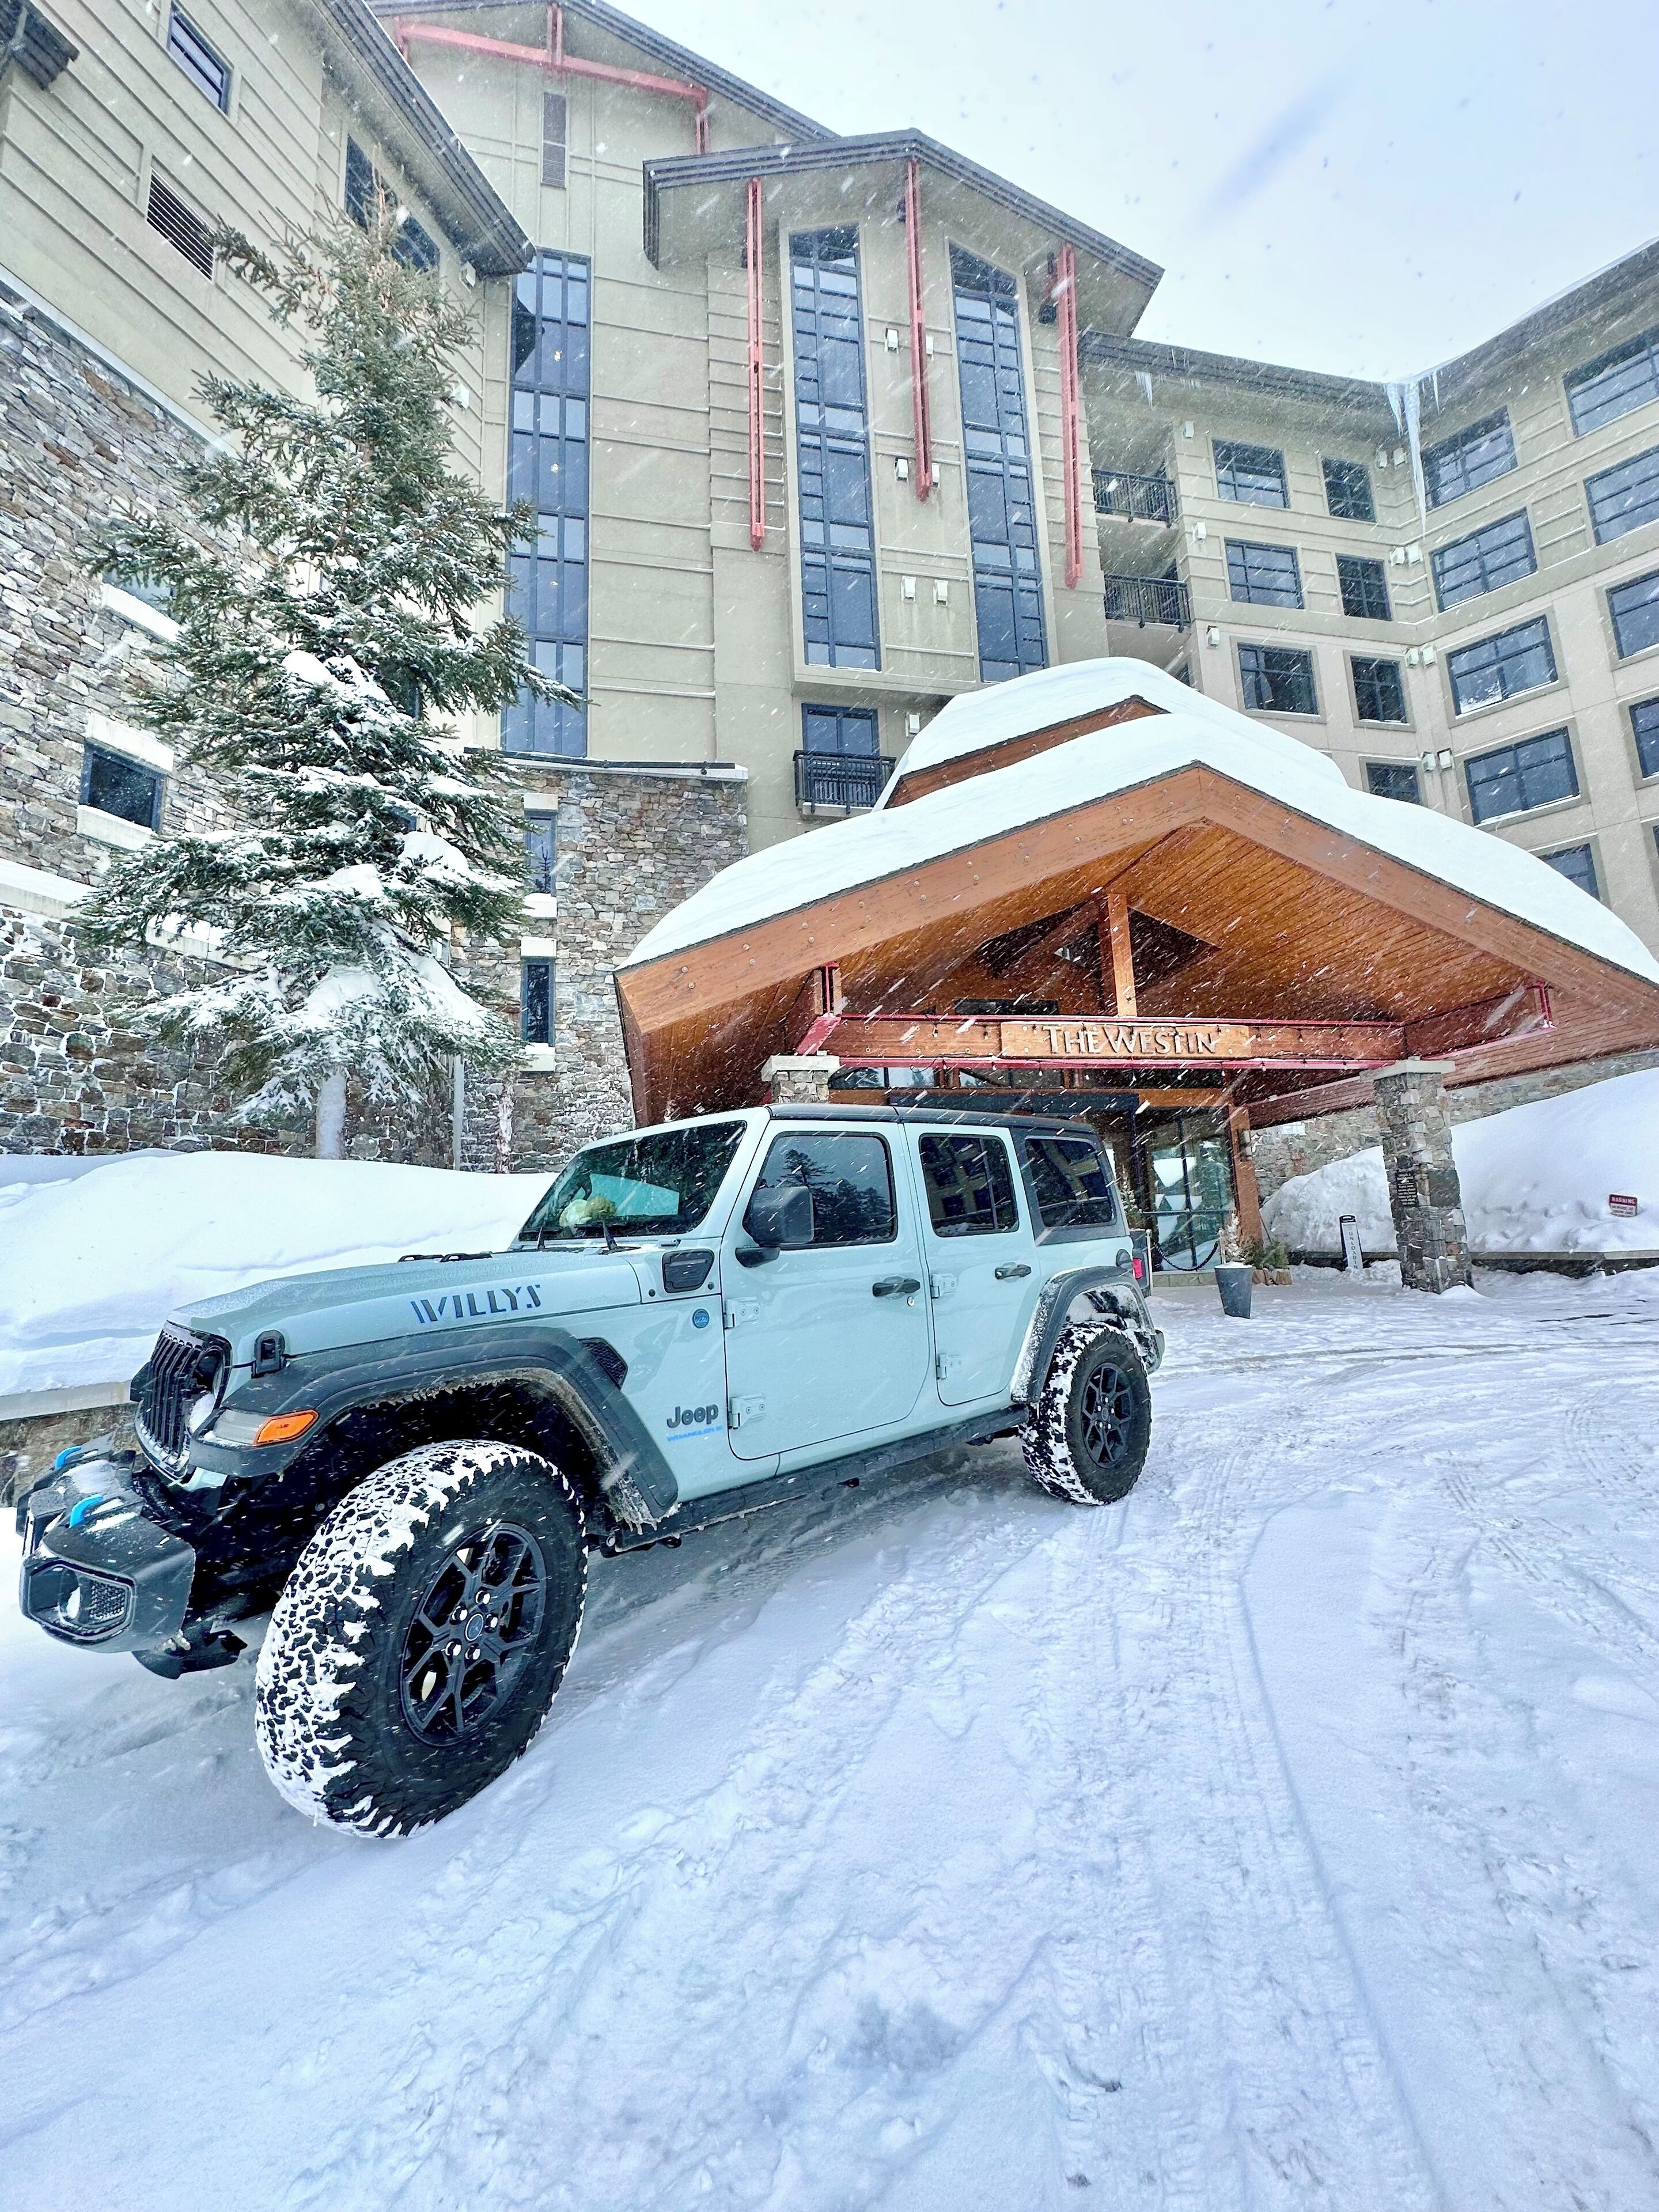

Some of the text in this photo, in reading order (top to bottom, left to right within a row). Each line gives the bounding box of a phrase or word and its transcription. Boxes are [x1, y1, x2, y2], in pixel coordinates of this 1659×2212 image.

[1042, 1024, 1217, 1055] THE WESTIN
[410, 1284, 541, 1324] WILLYS
[666, 1404, 719, 1429] Jeep
